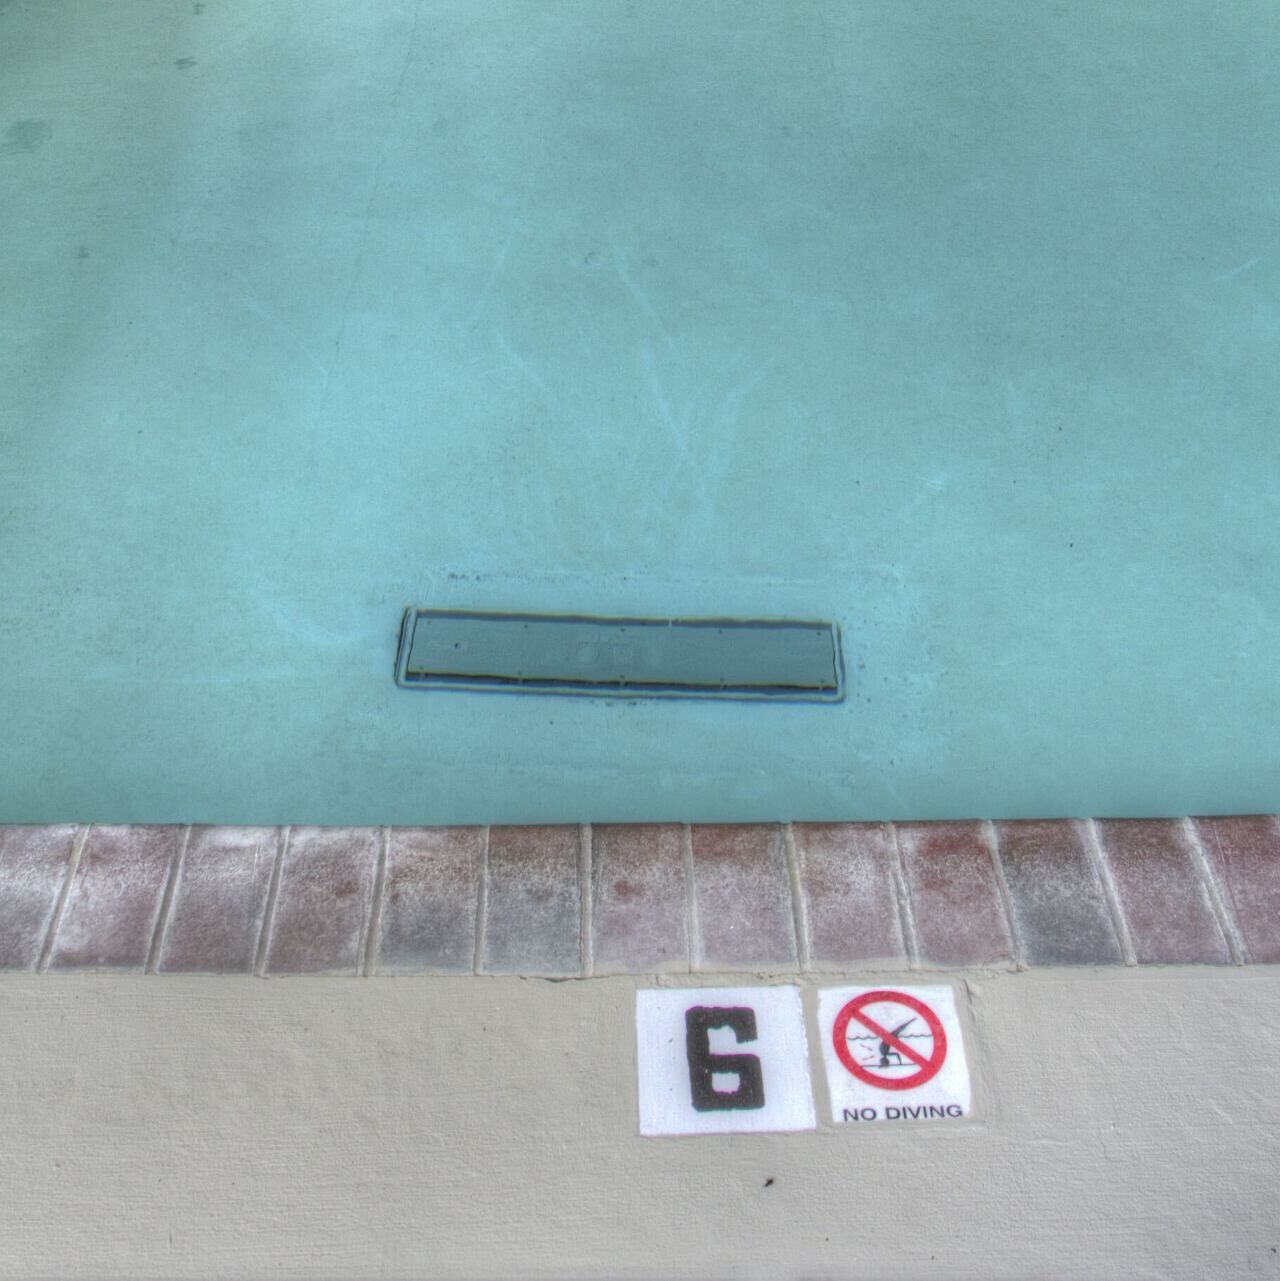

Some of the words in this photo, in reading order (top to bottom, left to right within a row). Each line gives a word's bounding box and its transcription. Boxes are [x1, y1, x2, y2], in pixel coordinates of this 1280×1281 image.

[685, 1006, 765, 1112] 6
[842, 1107, 878, 1122] NO
[885, 1104, 964, 1121] DIVING
